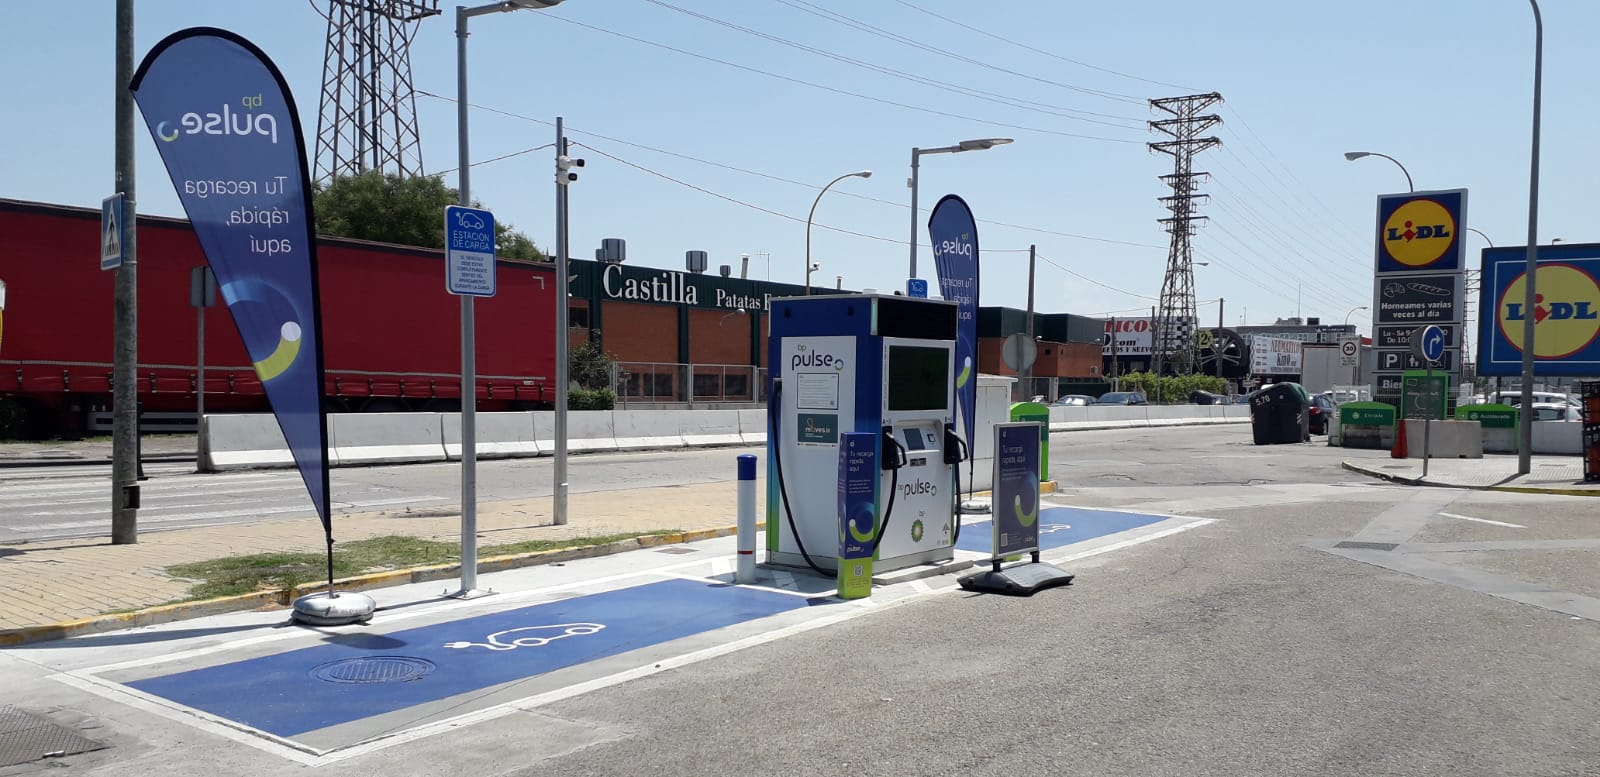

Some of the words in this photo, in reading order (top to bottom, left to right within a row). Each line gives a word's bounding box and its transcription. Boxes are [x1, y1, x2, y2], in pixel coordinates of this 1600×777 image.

[453, 230, 490, 242] ESTACIÓN
[453, 239, 464, 248] DE
[464, 240, 490, 250] CARGA
[603, 264, 698, 305] Castilla
[716, 288, 761, 310] Patatas
[1381, 302, 1426, 311] Horneamos
[1427, 300, 1452, 310] varias
[1392, 311, 1416, 319] veces
[1417, 310, 1425, 318] al
[791, 349, 833, 371] pulse
[1385, 353, 1398, 369] P
[904, 477, 930, 501] pulse
